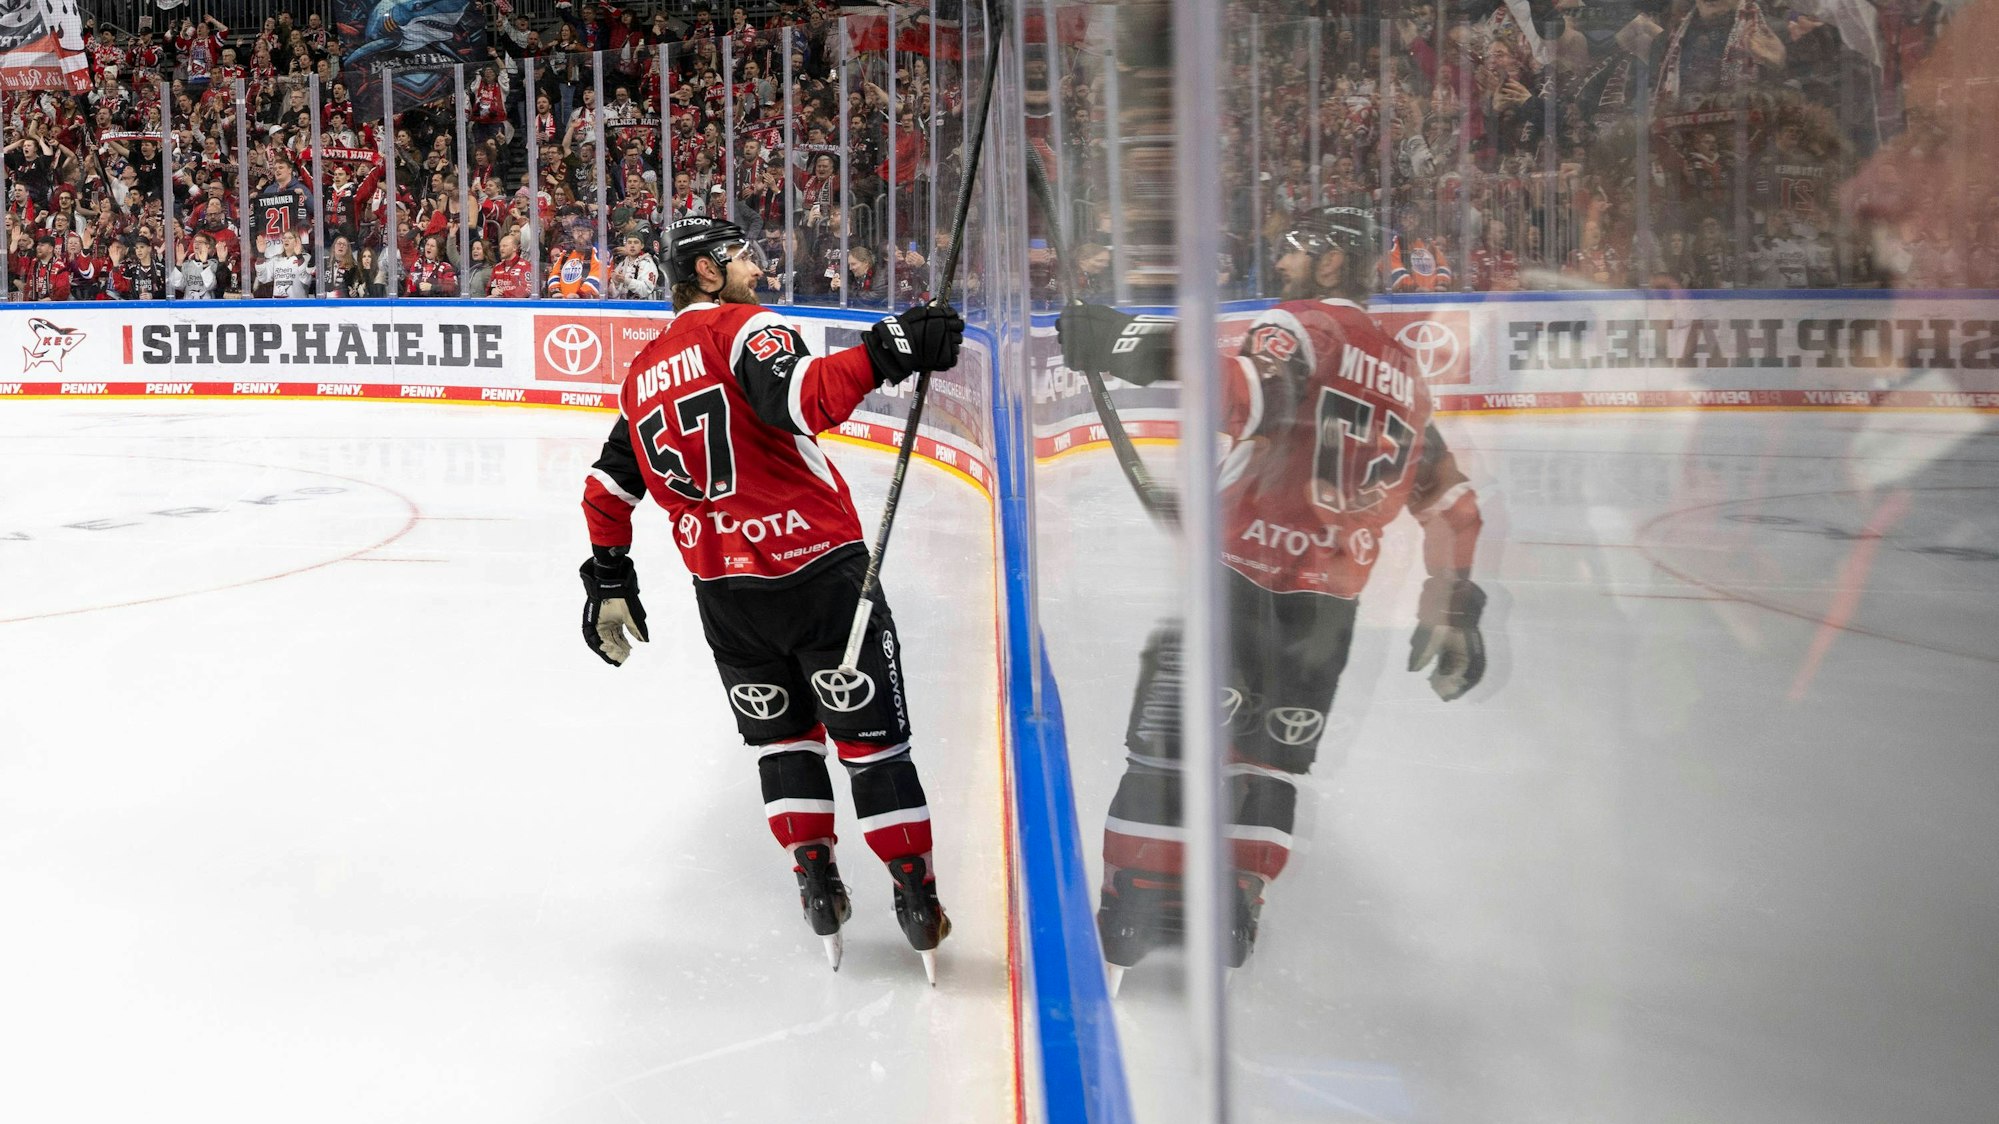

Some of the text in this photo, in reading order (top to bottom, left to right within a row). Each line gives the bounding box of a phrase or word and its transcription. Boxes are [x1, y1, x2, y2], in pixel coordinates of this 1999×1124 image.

[350, 150, 374, 161] HAIE
[265, 206, 290, 235] 21
[664, 217, 712, 233] STETSON
[43, 336, 73, 346] KEC
[142, 323, 503, 368] SHOP.HAIE.DE
[746, 328, 795, 362] 57
[637, 344, 707, 406] AUSTIN
[60, 383, 109, 394] PENNY.
[145, 383, 195, 395] PENNY.
[232, 382, 281, 394] PENNY.
[317, 383, 364, 396] PENNY.
[400, 385, 447, 398] PENNY.
[481, 388, 526, 402] PENNY.
[561, 392, 604, 407] PENNY.
[636, 383, 737, 502] 57
[706, 509, 811, 543] TOOTA
[783, 541, 831, 560] BAUER
[886, 660, 907, 732] TOYOTA
